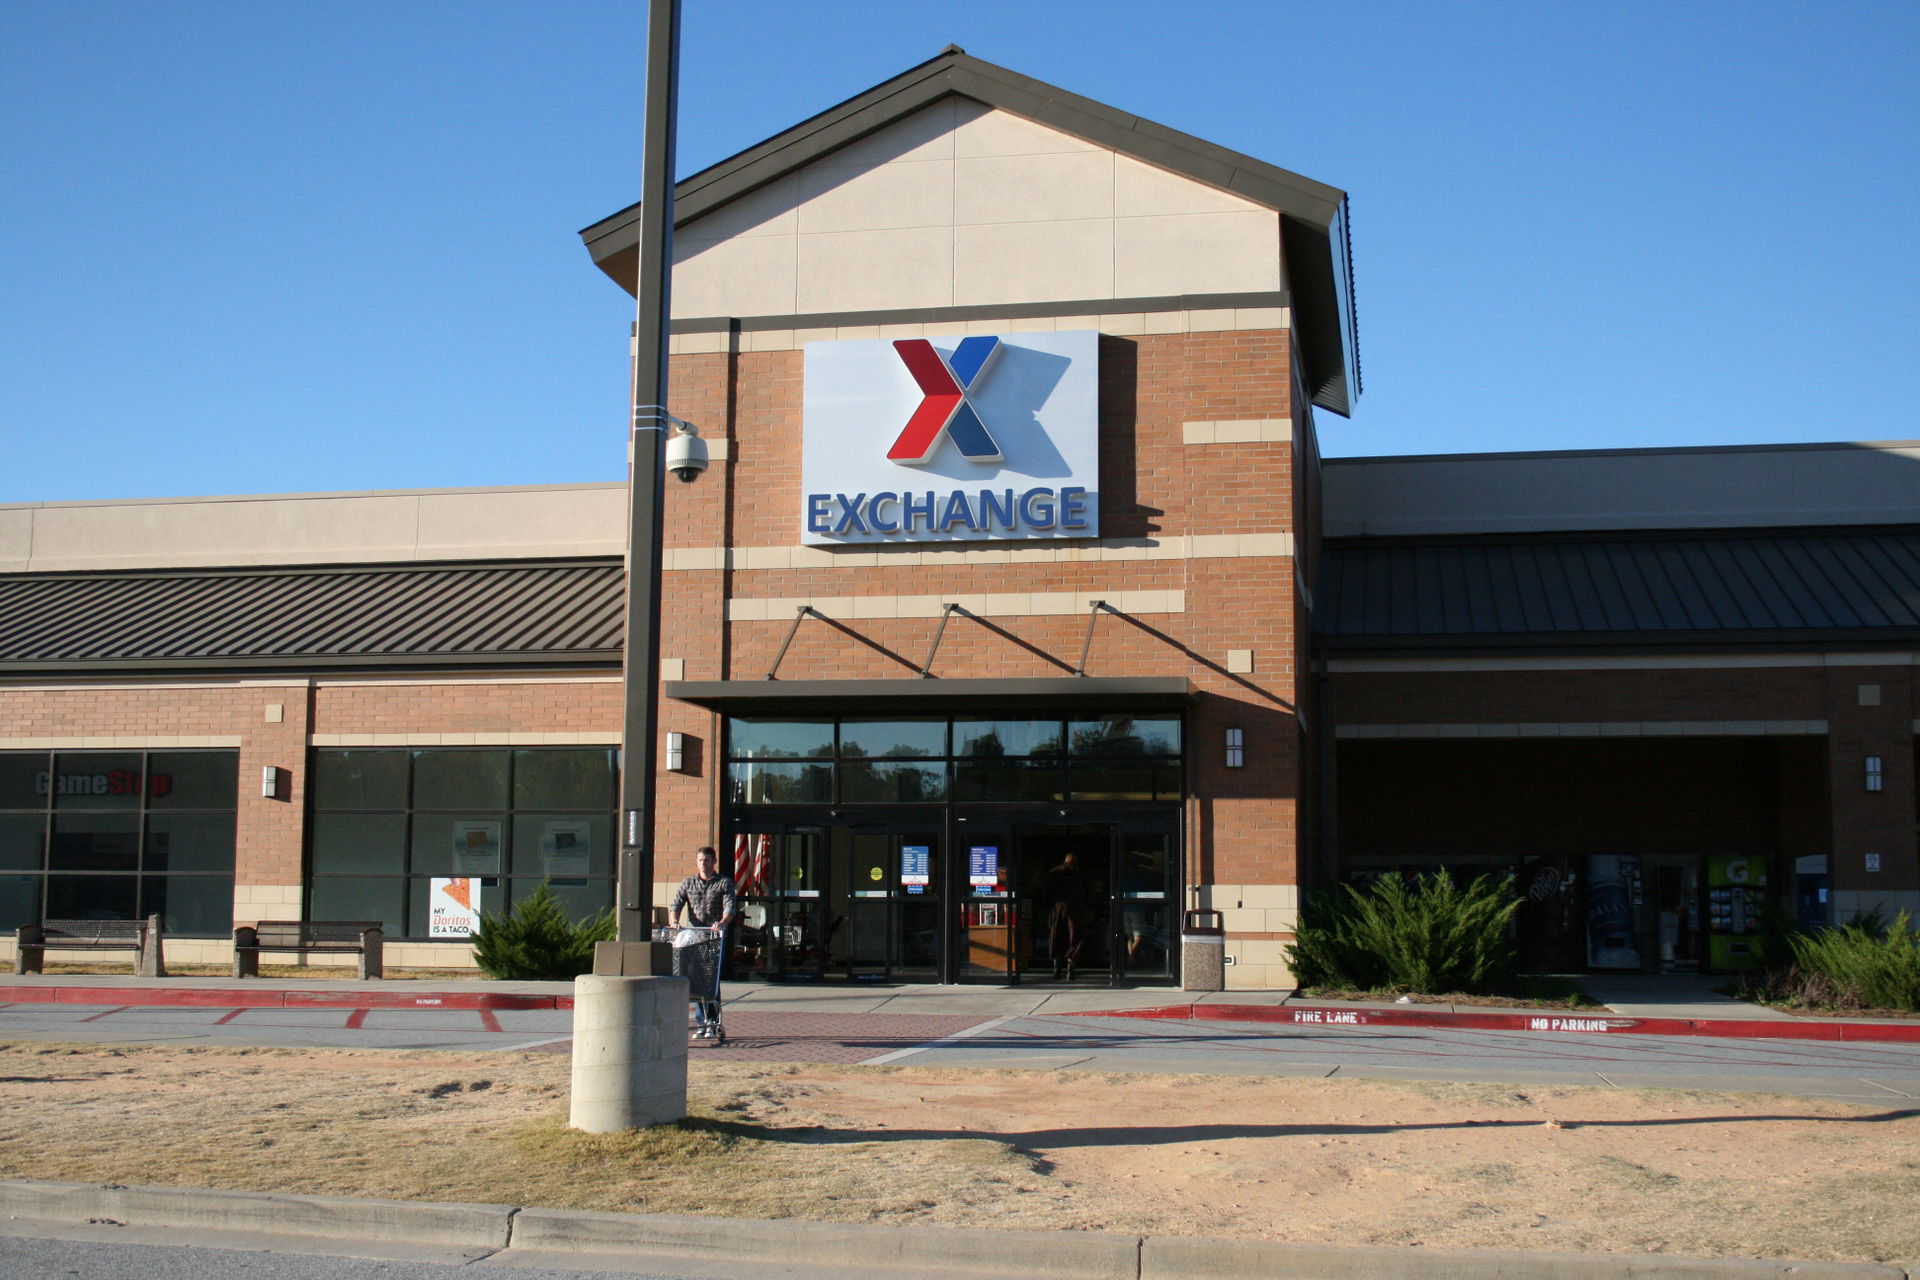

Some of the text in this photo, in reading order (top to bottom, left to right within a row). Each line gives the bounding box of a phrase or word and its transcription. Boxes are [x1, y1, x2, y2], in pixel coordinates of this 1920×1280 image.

[807, 486, 1088, 535] EXCHANGE
[433, 914, 472, 926] Doritos
[1294, 1010, 1358, 1024] FIRE LANE
[1531, 1018, 1607, 1032] NO PARKING
